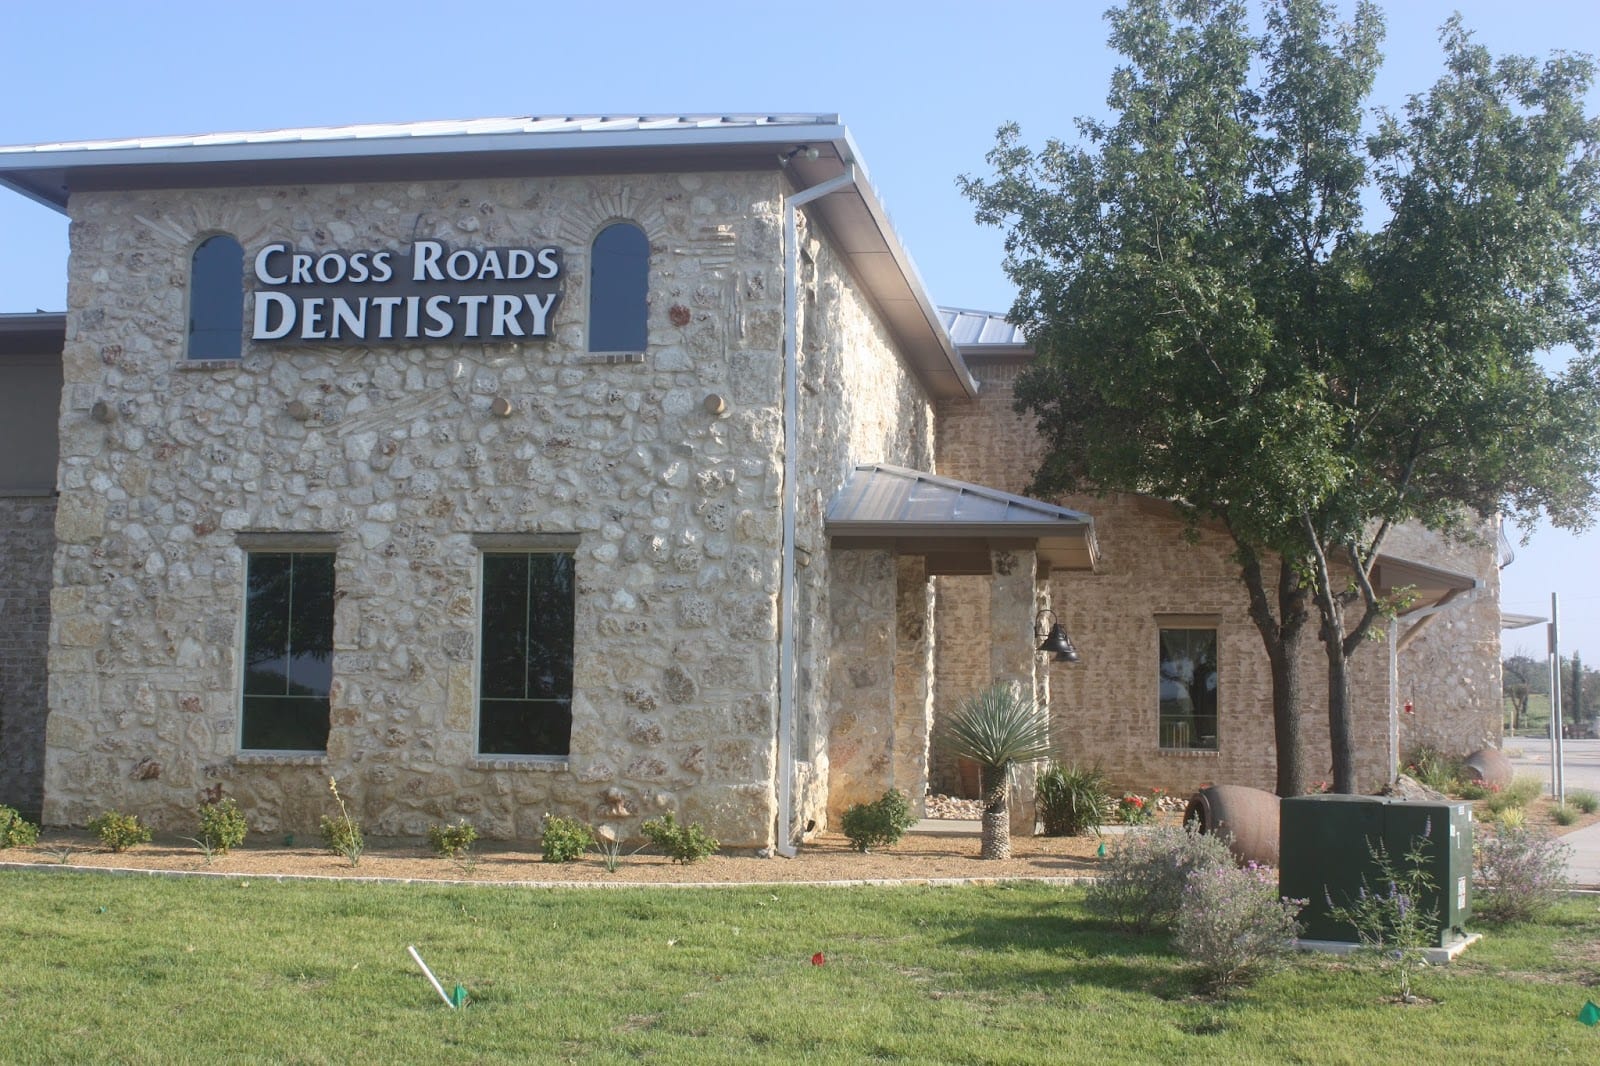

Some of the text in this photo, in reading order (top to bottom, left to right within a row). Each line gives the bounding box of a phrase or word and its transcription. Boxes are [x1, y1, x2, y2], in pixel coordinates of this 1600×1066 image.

[254, 241, 559, 285] CROSS ROADS
[251, 290, 556, 340] DENTISTRY
